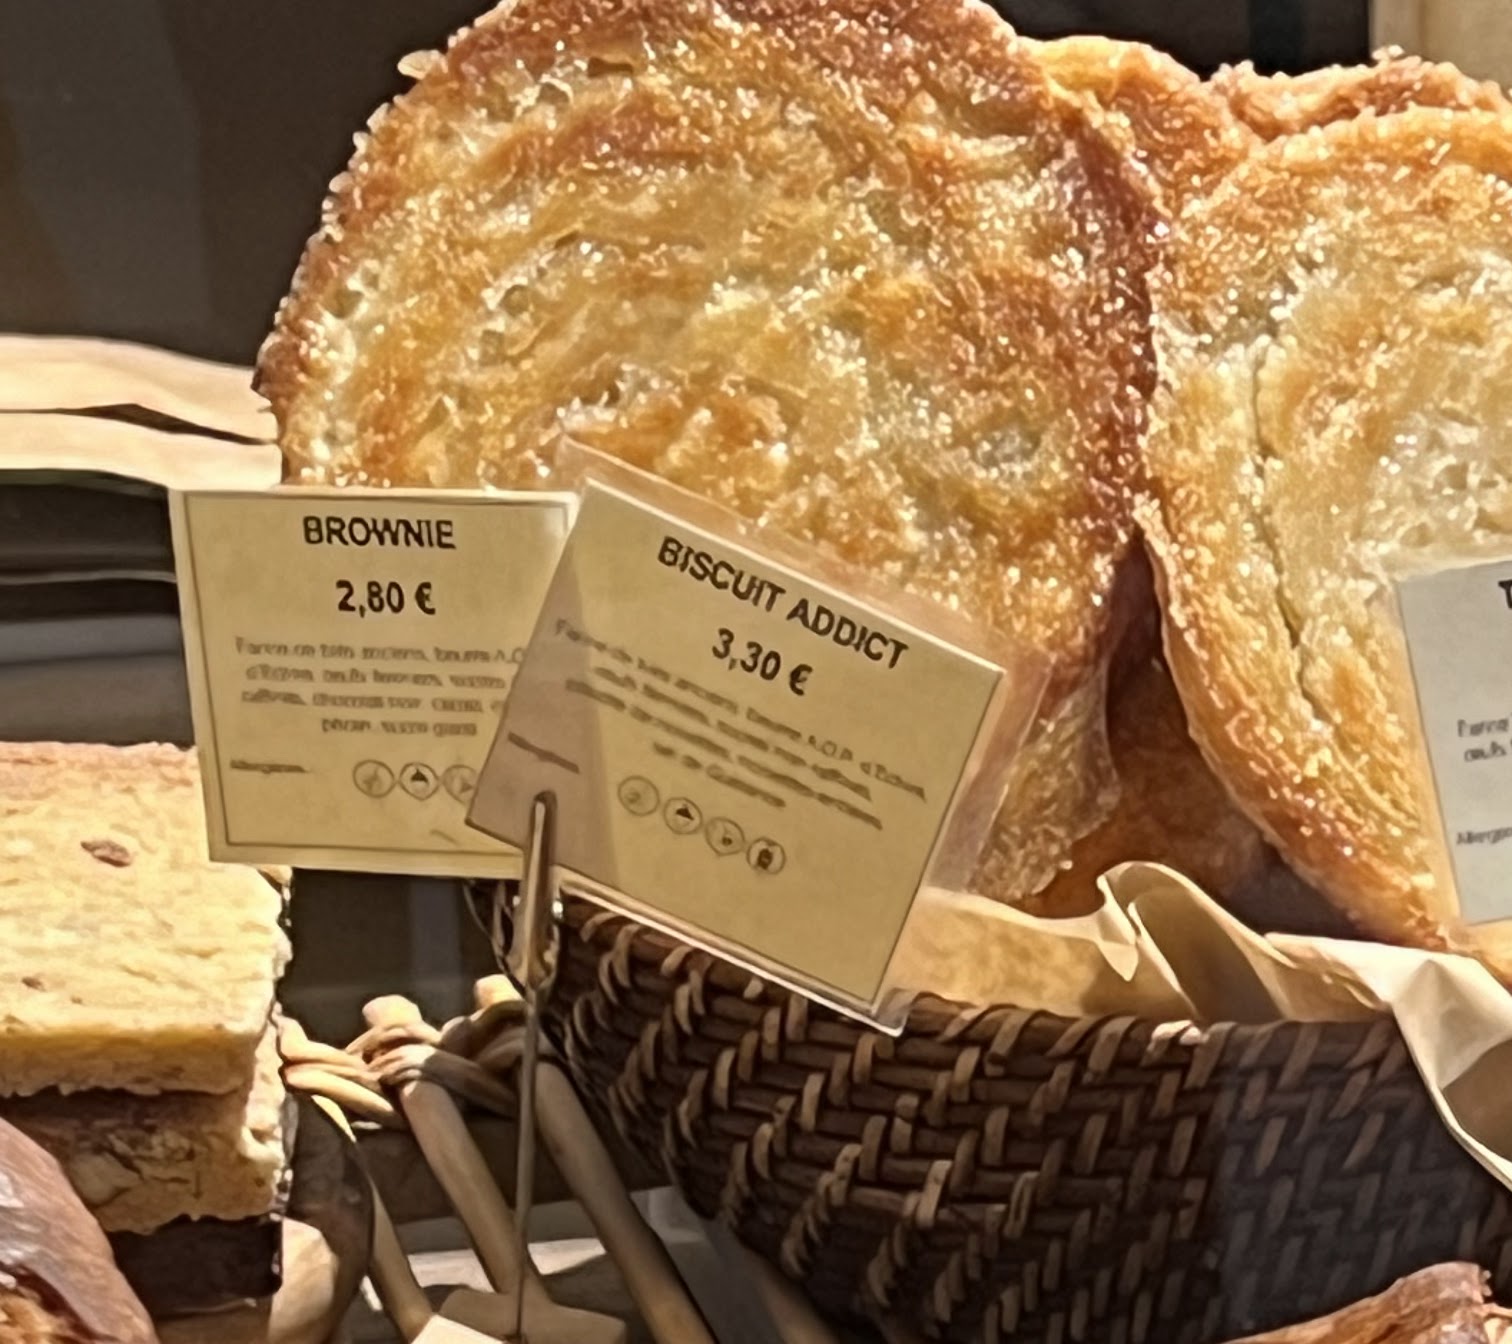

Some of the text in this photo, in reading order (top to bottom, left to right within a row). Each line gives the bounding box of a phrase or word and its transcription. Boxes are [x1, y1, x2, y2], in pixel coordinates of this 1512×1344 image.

[303, 515, 457, 550] BROWNIE
[335, 579, 436, 618] 2,80 €
[657, 535, 909, 669] BISCUIT ADDICT
[711, 627, 781, 681] 3,30
[789, 663, 814, 696] €
